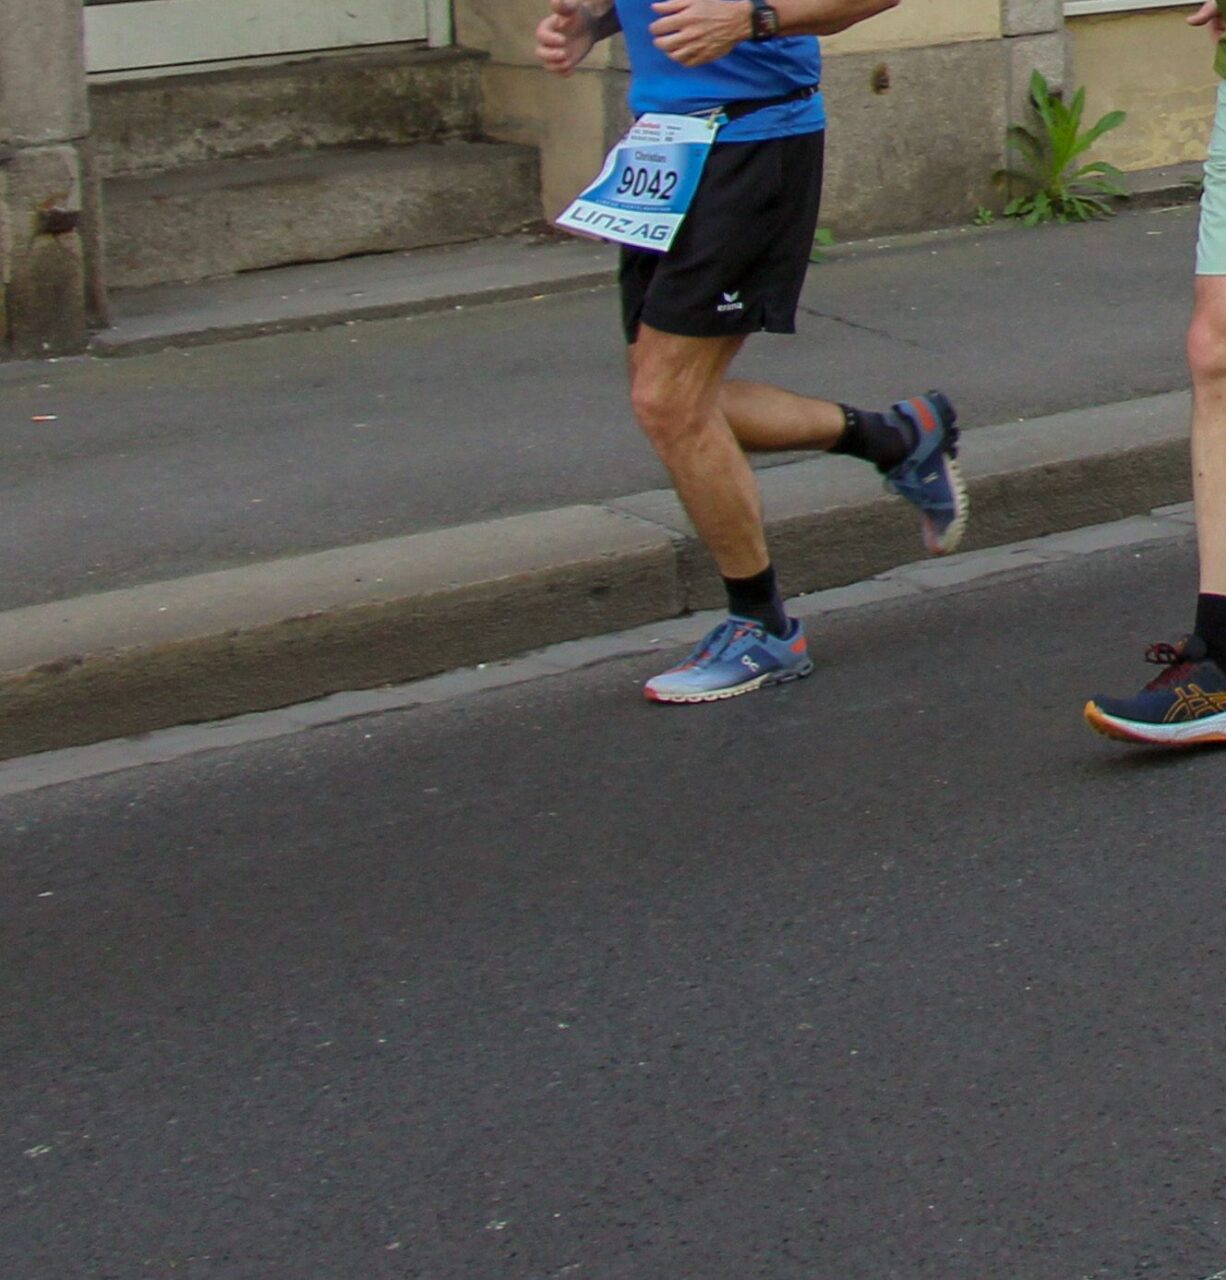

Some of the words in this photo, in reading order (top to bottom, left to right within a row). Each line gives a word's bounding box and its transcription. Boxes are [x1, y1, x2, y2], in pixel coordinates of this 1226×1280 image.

[616, 166, 678, 200] 9042
[570, 206, 633, 233] LINZ
[631, 223, 670, 241] AG
